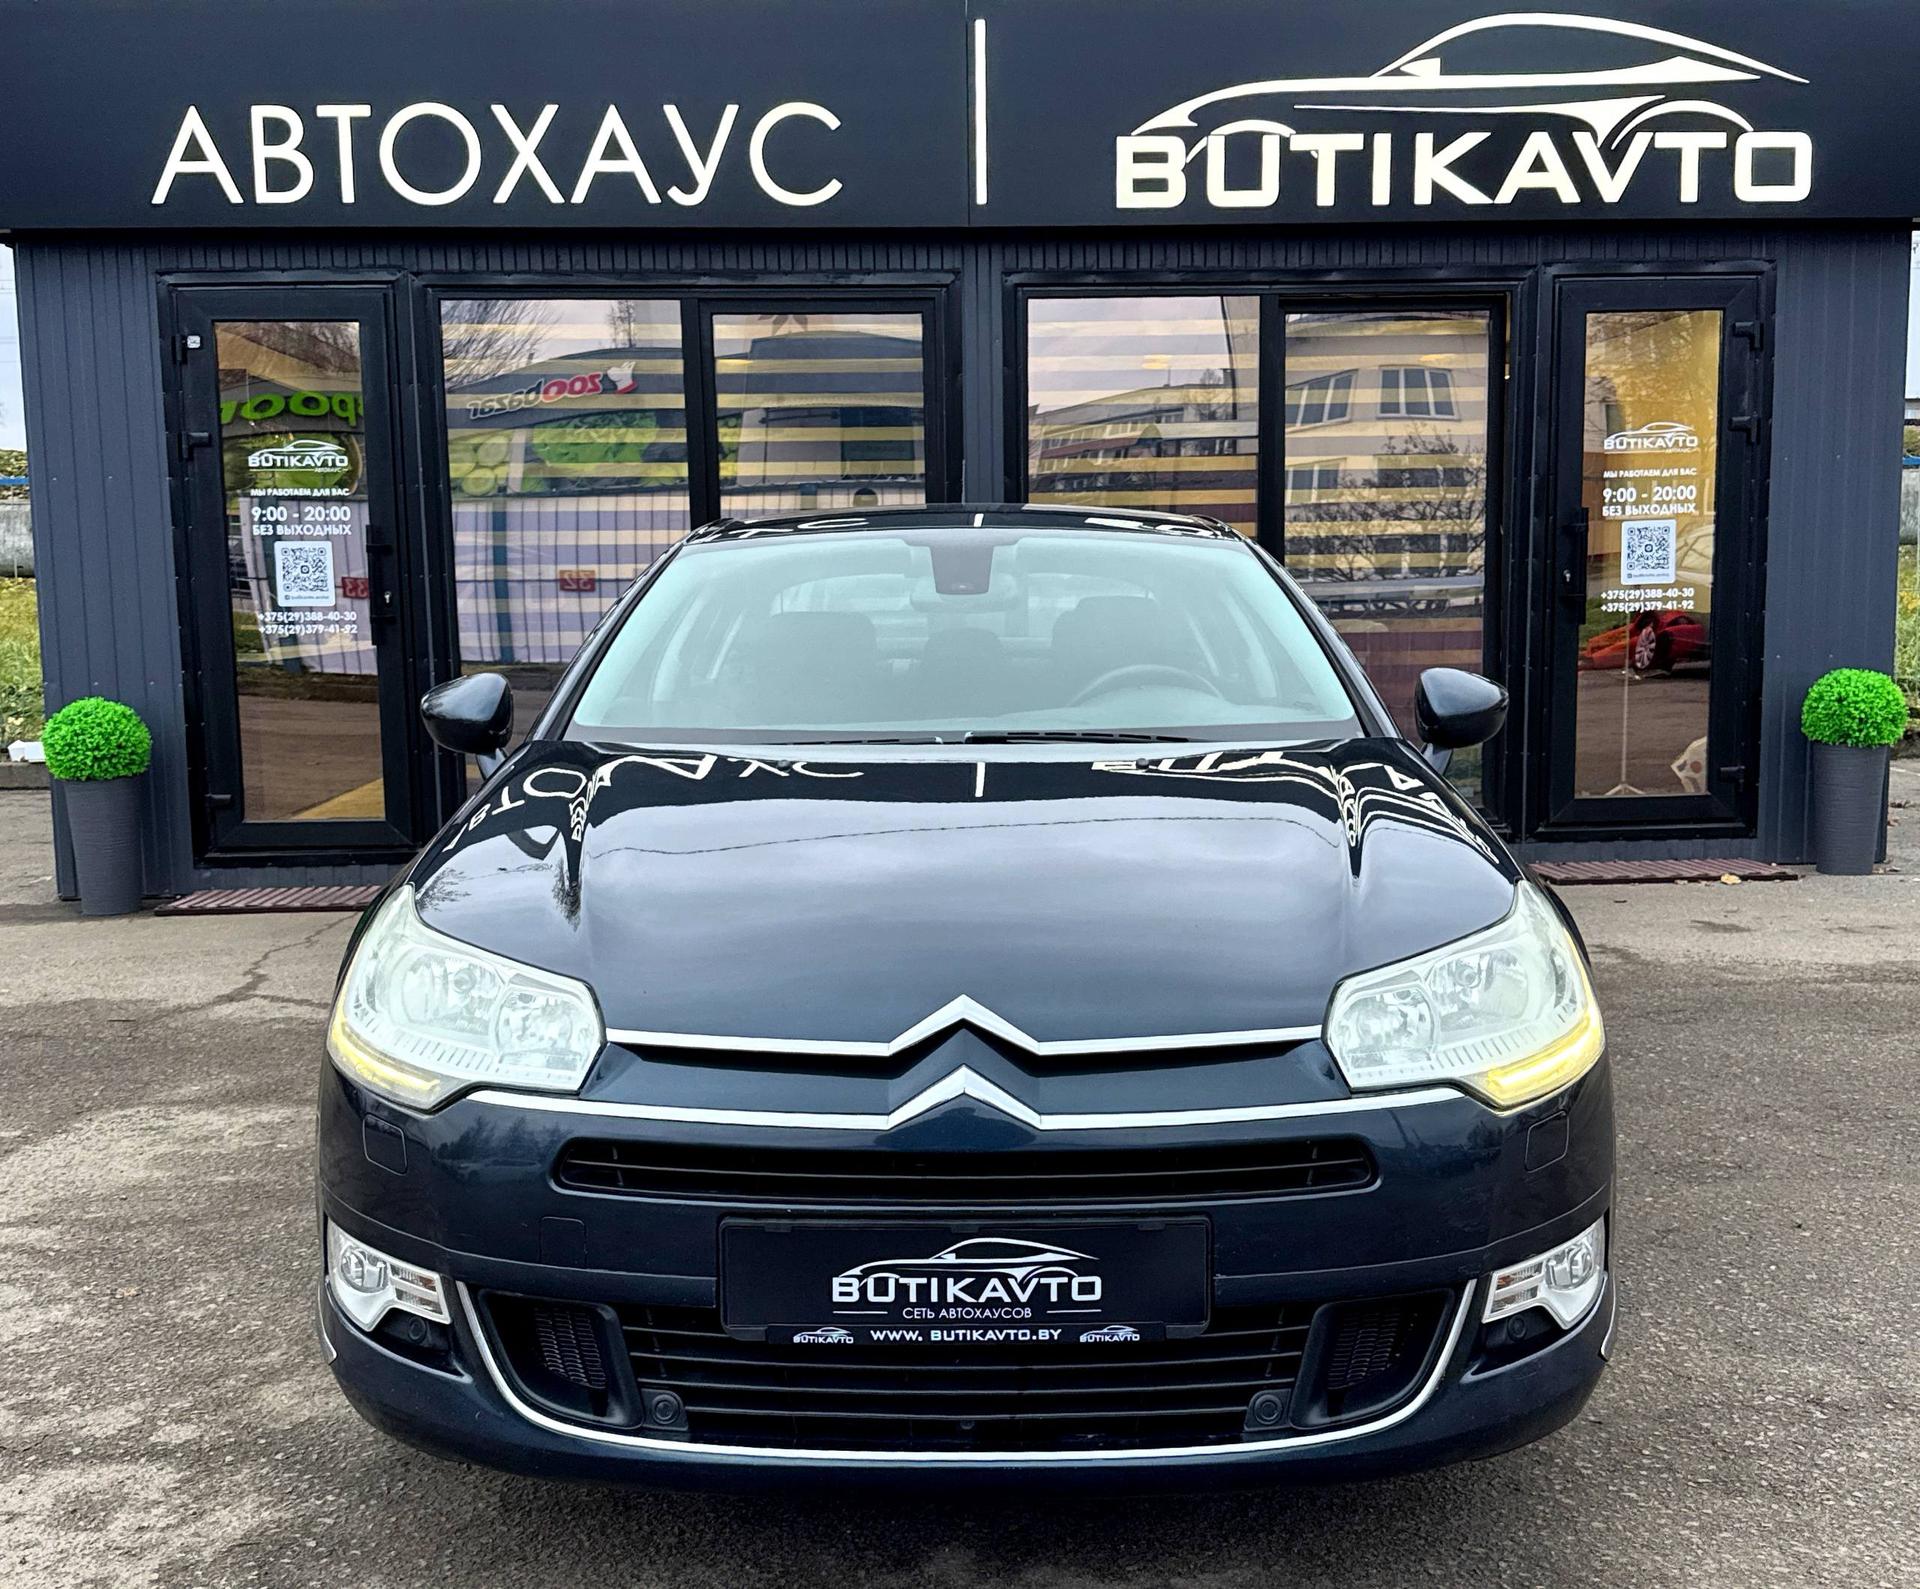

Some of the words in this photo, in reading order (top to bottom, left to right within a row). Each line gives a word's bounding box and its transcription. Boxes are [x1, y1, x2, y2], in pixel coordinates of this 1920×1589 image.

[152, 101, 843, 208] АВТОХАУС
[1116, 130, 1812, 209] BUTIKAVTO
[1603, 436, 1698, 450] BUTIKAVTO
[248, 455, 348, 467] BUTIKAVTO
[1603, 470, 1618, 478] МЫ
[1619, 469, 1660, 478] РАБОТАЕМ
[1662, 468, 1679, 477] ДЛЯ
[1680, 468, 1697, 476] ВАС
[250, 488, 265, 496] МЫ
[267, 488, 311, 496] РАБОТАЕМ
[312, 488, 330, 497] ДЛЯ
[332, 488, 349, 496] ВАС
[1603, 487, 1637, 503] 9:00
[1653, 485, 1697, 501] 20:00
[251, 506, 287, 521] 9:00
[304, 506, 351, 521] 20:00
[1602, 506, 1622, 517] БЕЗ
[1625, 503, 1696, 515] ВЫХОДНЫХ
[252, 525, 273, 536] БЕЗ
[276, 524, 352, 537] ВЫХОДНЫХ
[1600, 588, 1694, 601] +375(29)388-40-30
[1600, 600, 1694, 613] +375(29)379-41-92
[257, 611, 357, 623] +375(29)388-40-30
[259, 624, 358, 636] +375(29)379-41-92
[832, 1275, 1102, 1303] BUTIKAVTO
[903, 1307, 935, 1319] СЕТЬ
[938, 1307, 1032, 1319] АВТОХАУСОВ
[870, 1330, 923, 1342] WWW.
[930, 1329, 1062, 1342] BUTIKAVTO.BY
